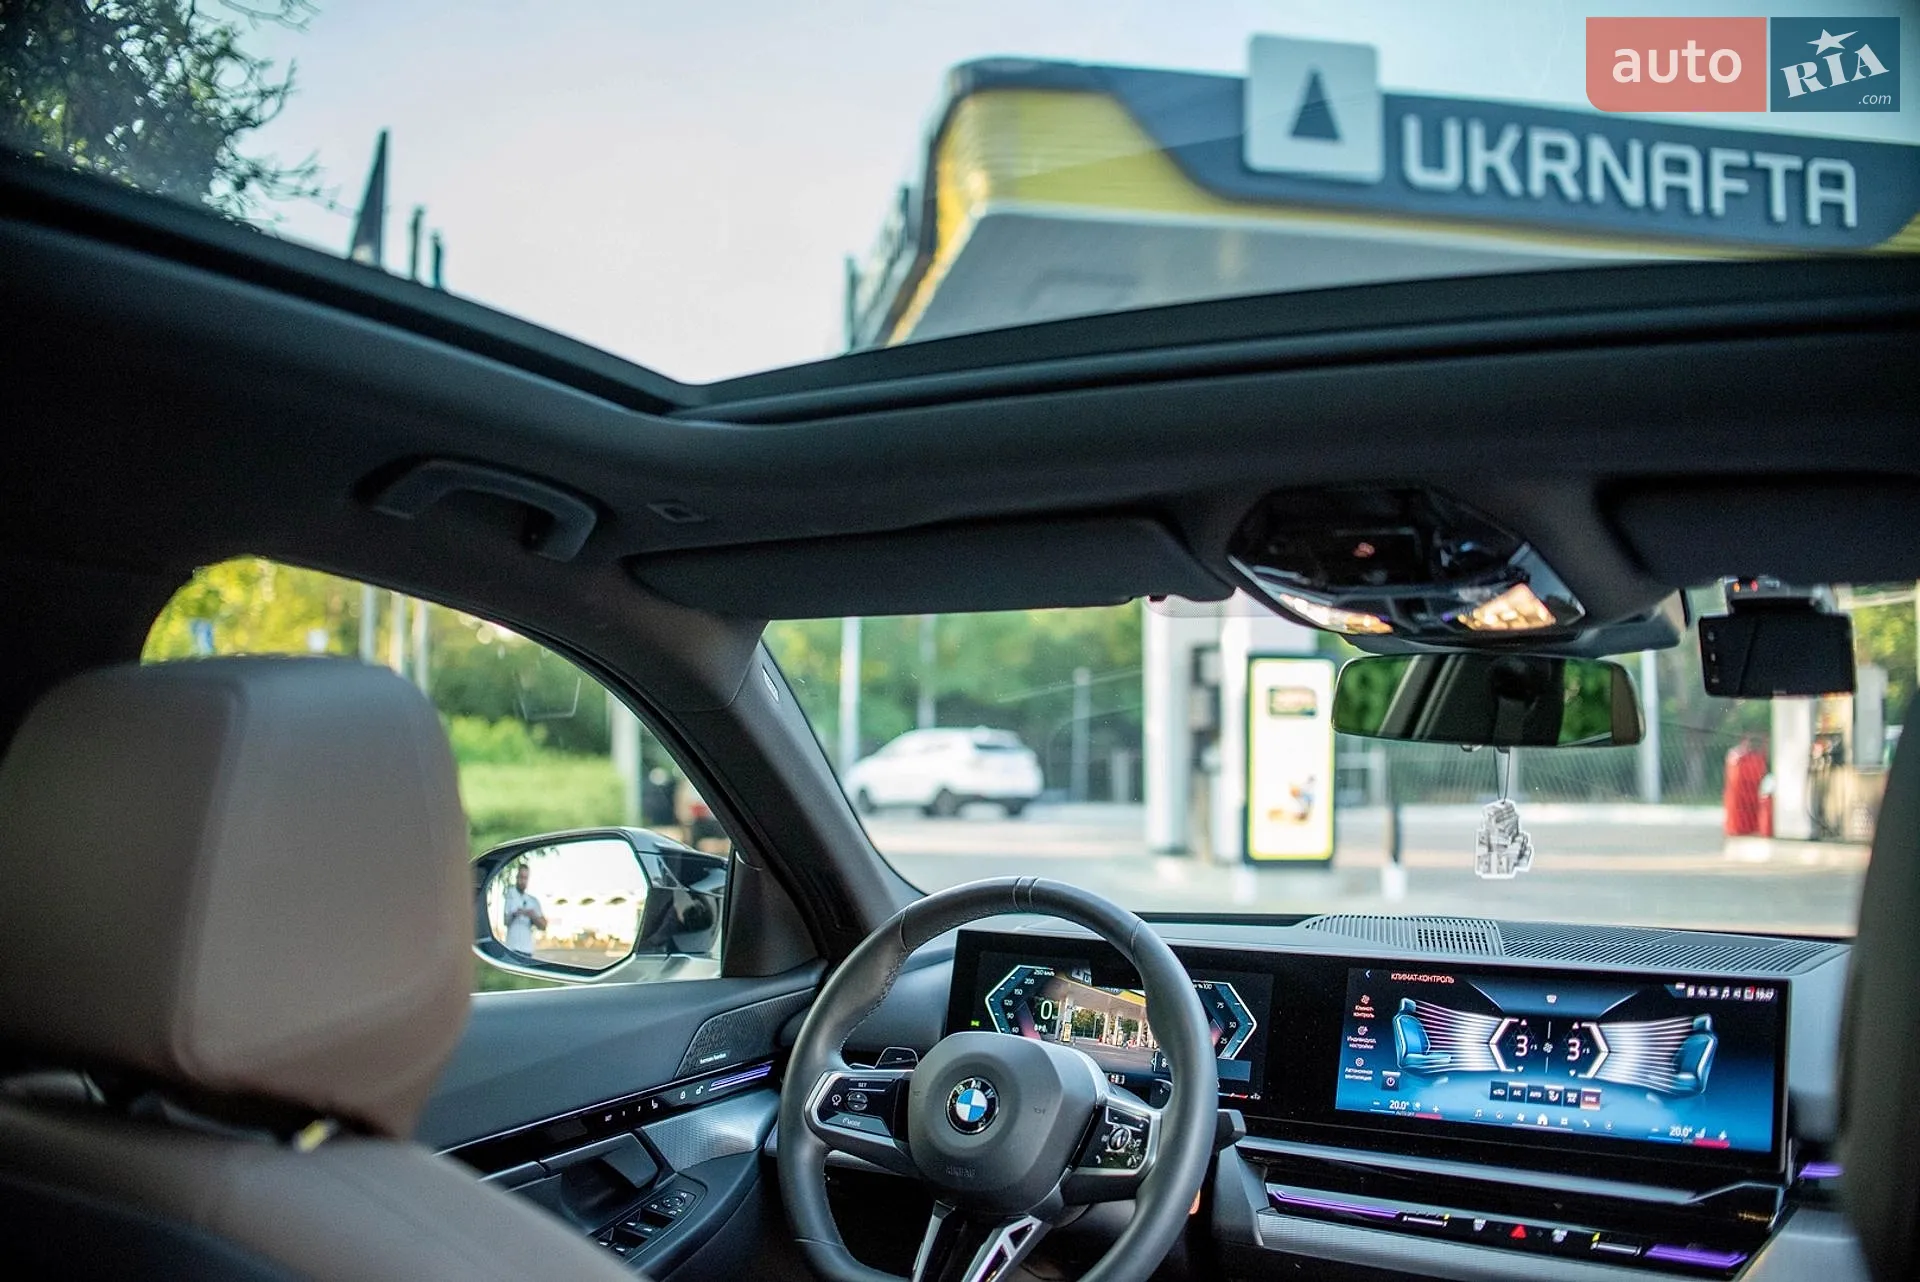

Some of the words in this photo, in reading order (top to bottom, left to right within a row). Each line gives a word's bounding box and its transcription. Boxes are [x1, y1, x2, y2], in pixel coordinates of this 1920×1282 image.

[1402, 112, 1858, 228] UKRNAFTA
[1391, 973, 1455, 984] КЛИМАТ-КОНТРОЛЬ
[1041, 1000, 1053, 1020] 0
[1515, 1035, 1528, 1057] 3
[1567, 1038, 1580, 1061] 3
[1389, 1100, 1409, 1110] 20.0°
[1669, 1126, 1692, 1137] 20.0°
